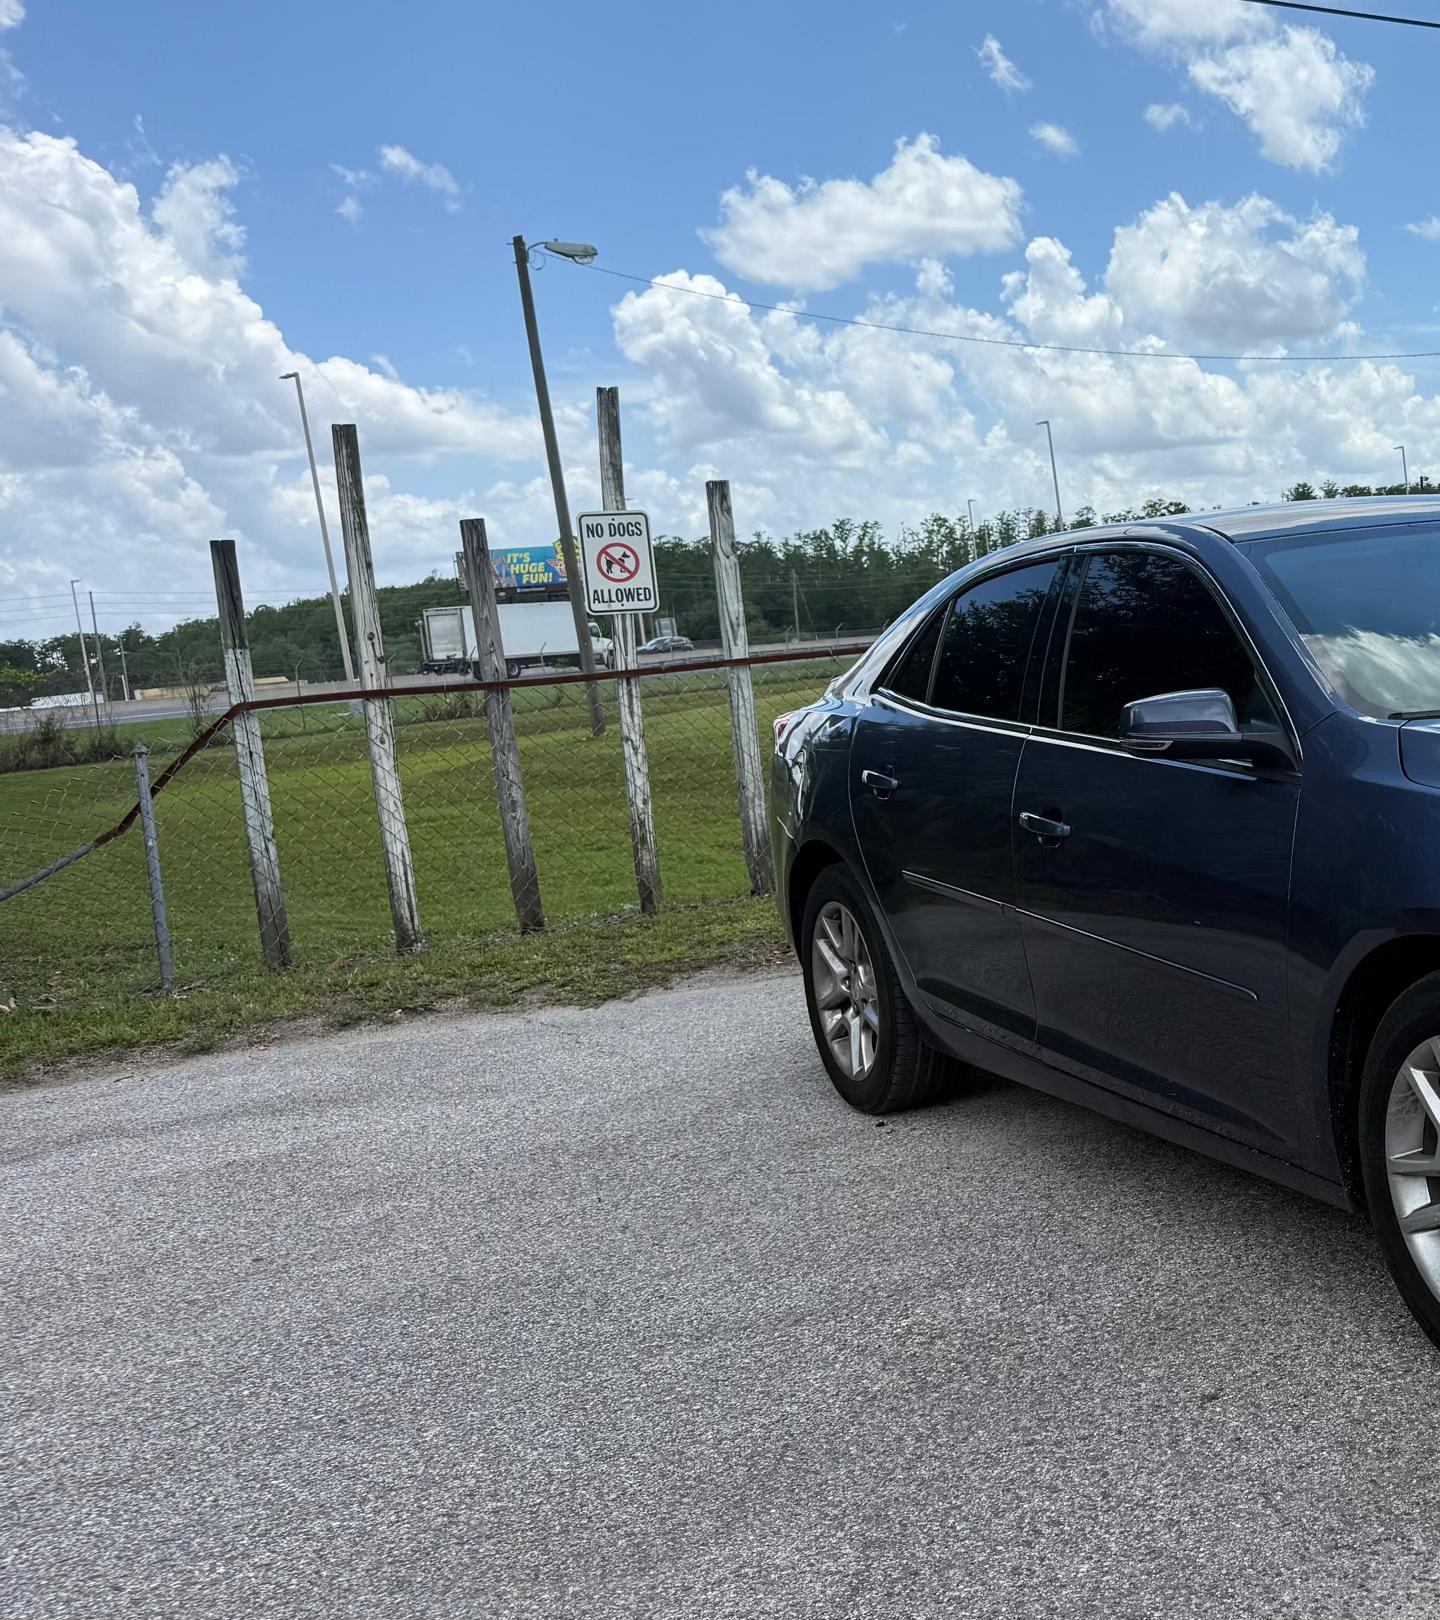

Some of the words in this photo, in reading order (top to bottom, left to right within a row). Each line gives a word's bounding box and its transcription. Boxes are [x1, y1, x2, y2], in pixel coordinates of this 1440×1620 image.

[586, 523, 604, 538] NO
[608, 521, 643, 537] DOGS
[507, 552, 531, 564] IT'S
[510, 562, 545, 574] HUGE
[522, 573, 553, 584] FUN!
[593, 587, 652, 604] ALLOWED
